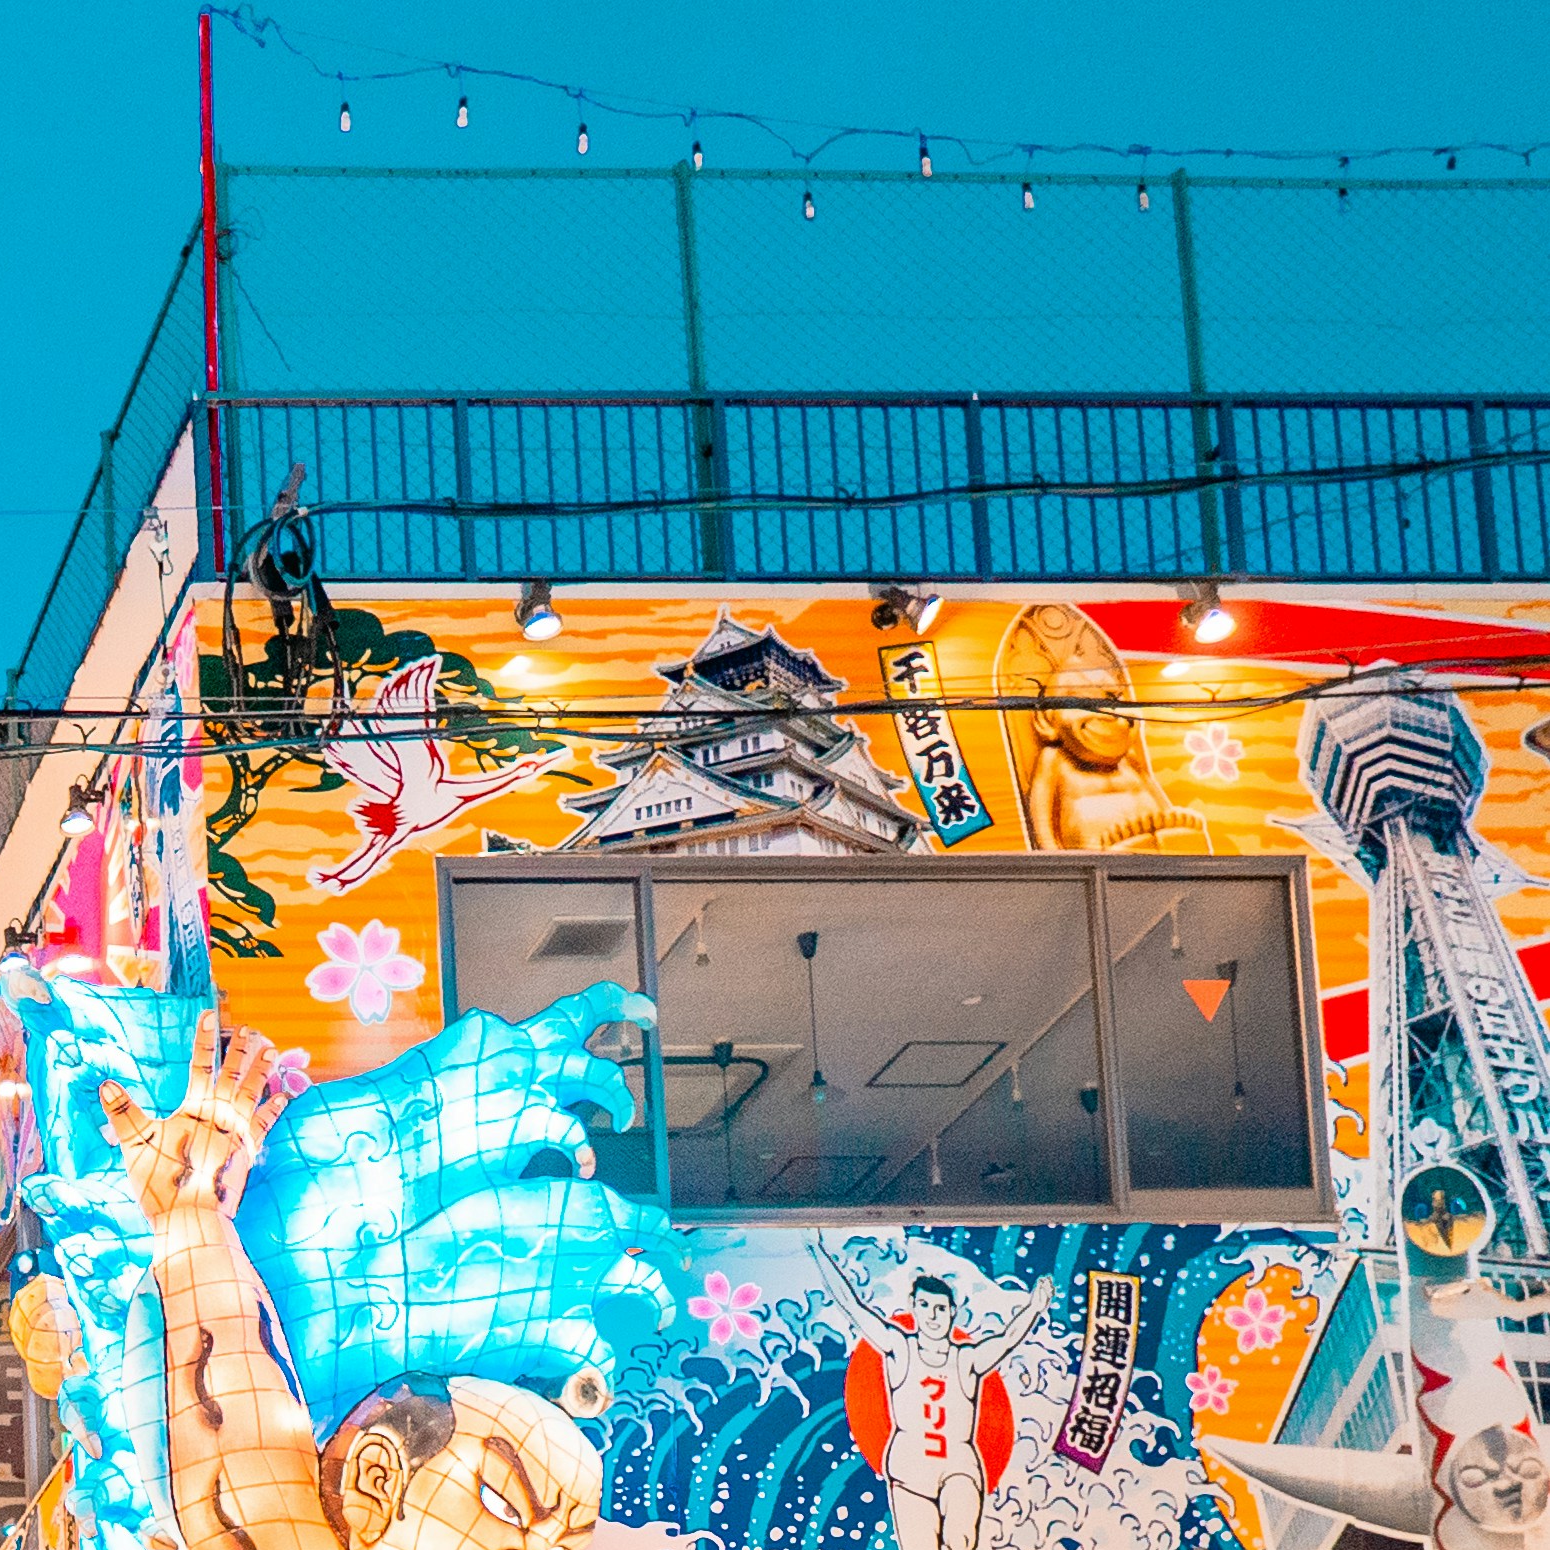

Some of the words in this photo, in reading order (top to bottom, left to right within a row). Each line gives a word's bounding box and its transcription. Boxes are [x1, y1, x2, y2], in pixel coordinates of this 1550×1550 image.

[888, 646, 982, 830] 千客万来
[918, 1375, 951, 1461] グリコ
[1068, 1278, 1134, 1456] 開運招福
